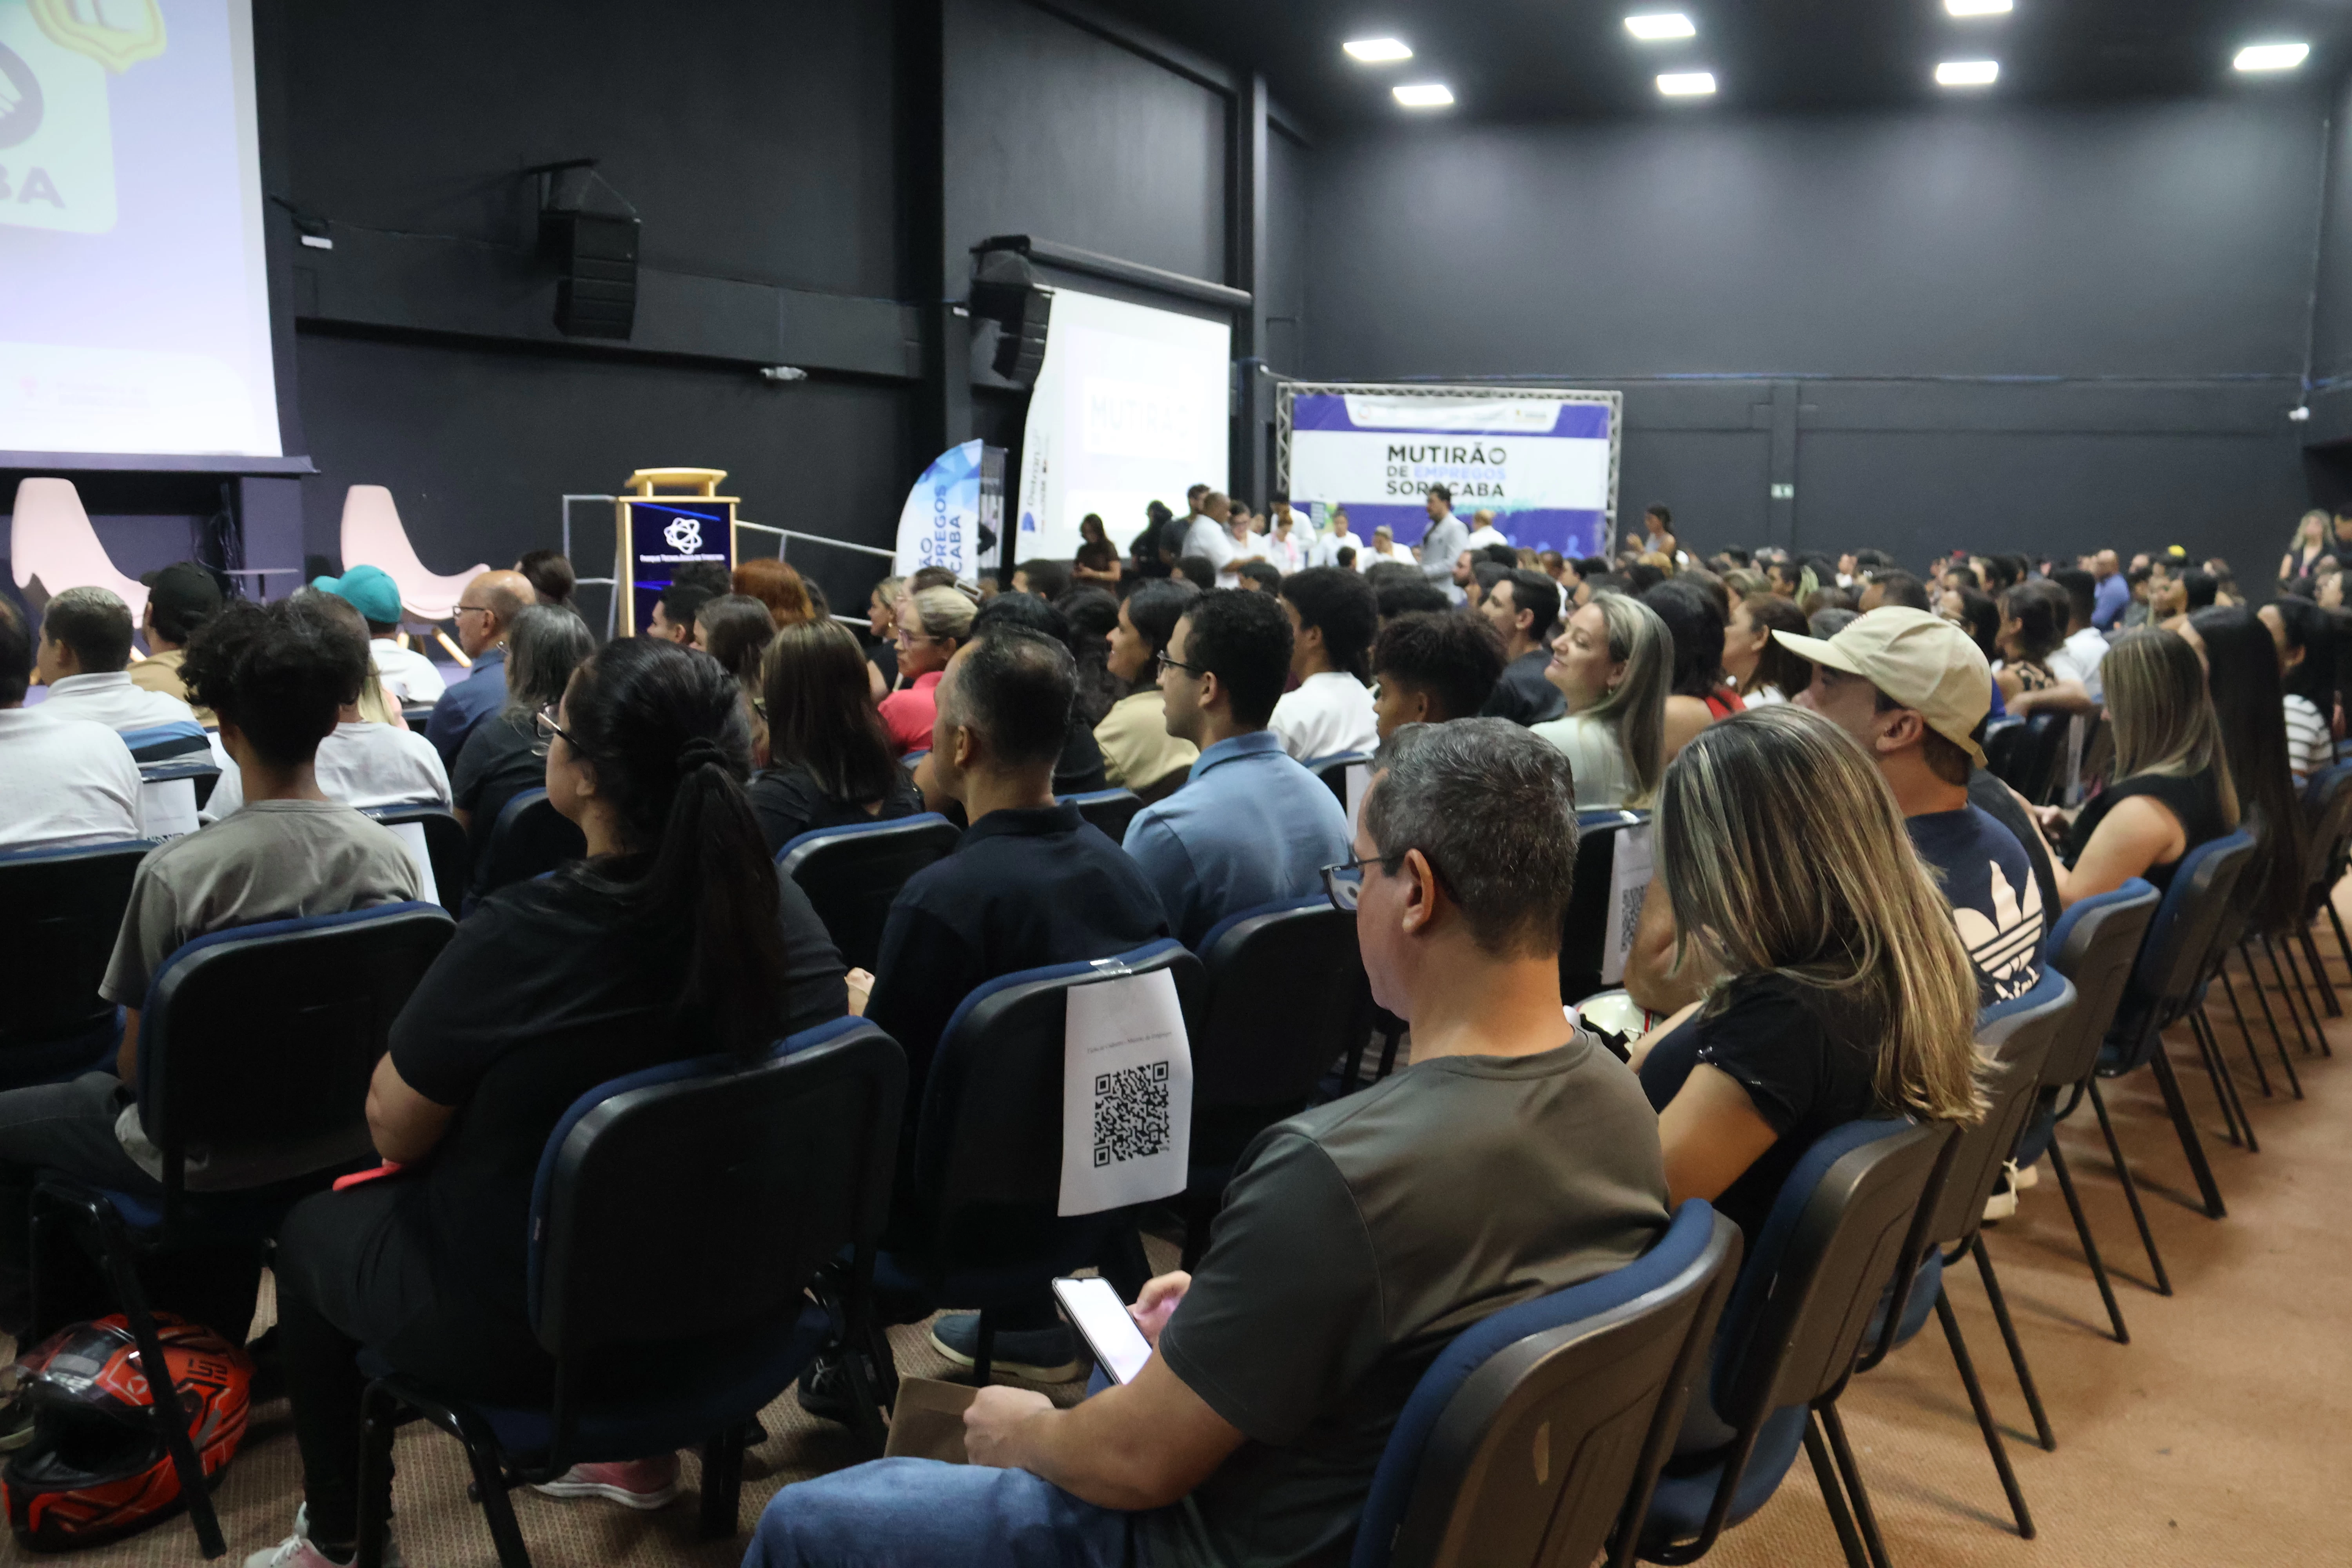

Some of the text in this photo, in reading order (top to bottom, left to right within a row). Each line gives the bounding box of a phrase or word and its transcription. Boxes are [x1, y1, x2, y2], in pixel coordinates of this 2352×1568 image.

[1388, 442, 1506, 465] MUTIRÃO
[1387, 466, 1506, 479] DE EMPREGOS
[1387, 481, 1504, 497] SORCABA
